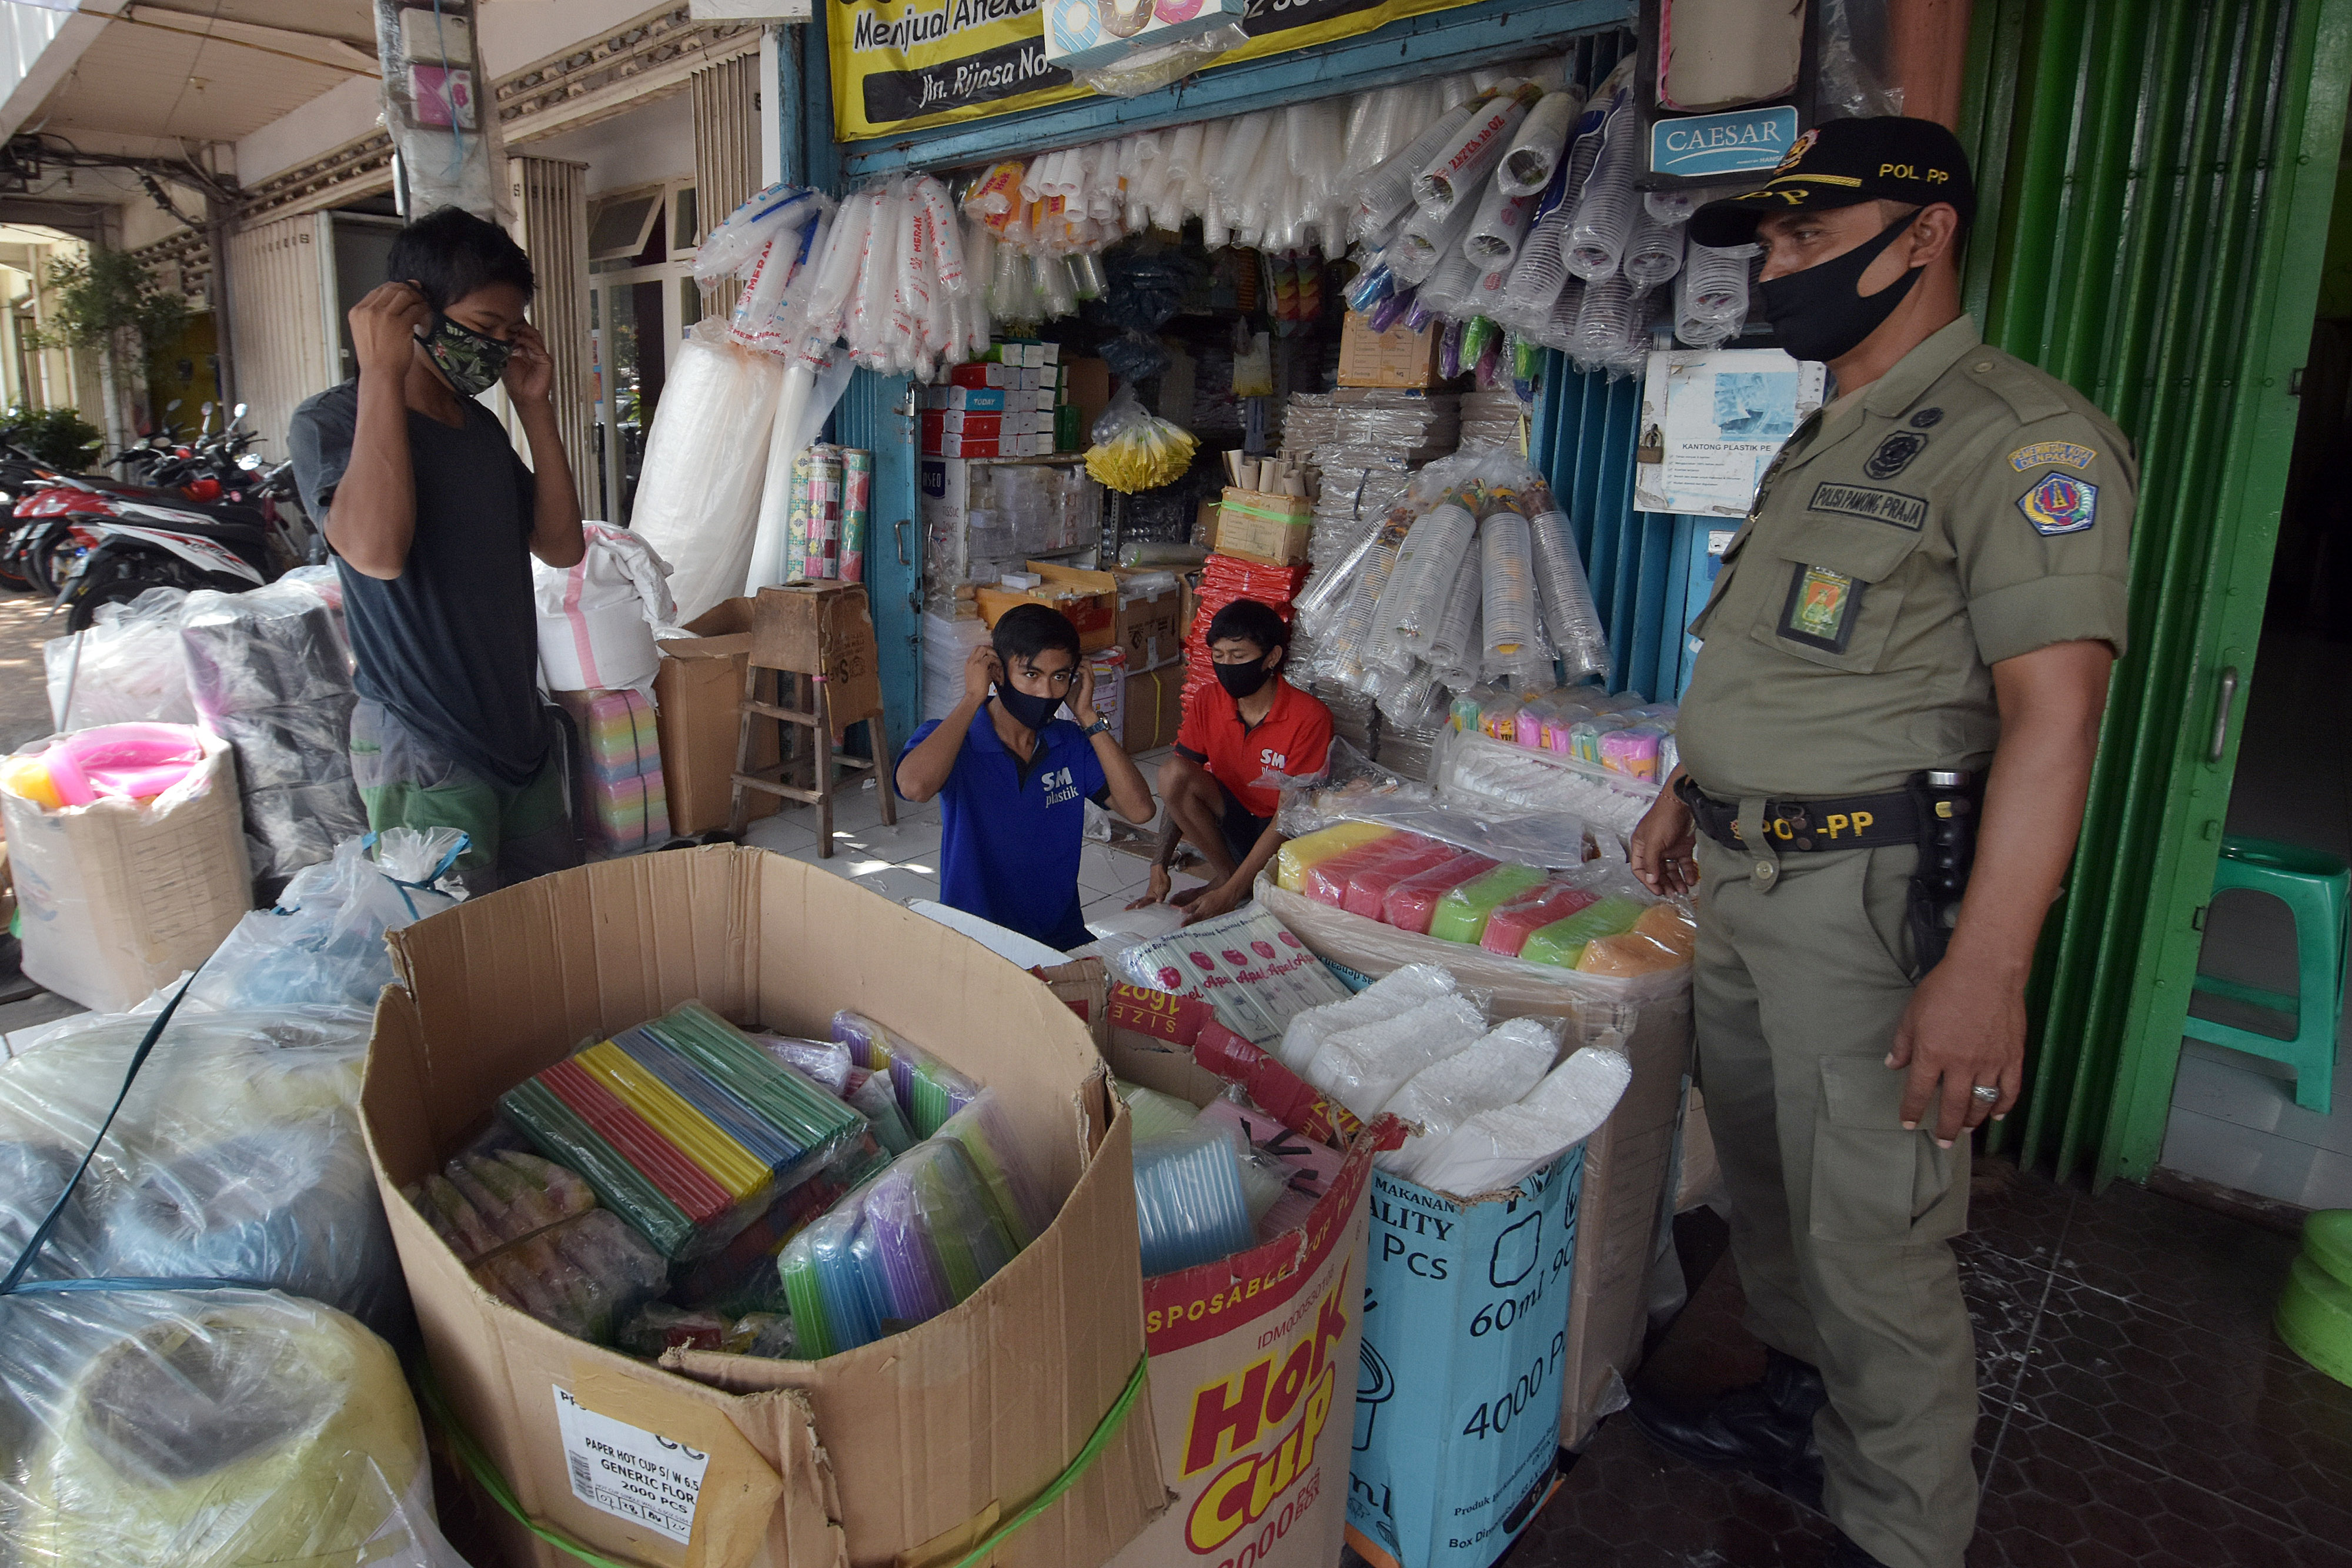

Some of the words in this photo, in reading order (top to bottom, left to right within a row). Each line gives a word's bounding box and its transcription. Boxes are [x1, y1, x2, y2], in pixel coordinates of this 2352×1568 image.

[854, 9, 949, 52] Menjual
[953, 62, 1014, 98] Rijasa
[1019, 46, 1053, 80] No.
[1666, 121, 1782, 152] CAESAR
[1879, 163, 1920, 180] POL
[1927, 168, 1949, 185] PP
[913, 215, 923, 253] MERAK
[973, 397, 996, 406] TODAY
[2020, 453, 2082, 468] DENPASAR
[1815, 487, 1846, 509] POLISI
[1846, 490, 1883, 514] PAMONG
[1880, 496, 1922, 524] PRAJA
[1259, 748, 1285, 769] SM
[1041, 766, 1073, 792] SM
[1045, 785, 1080, 809] plastik
[1267, 958, 1298, 976] Apel
[1113, 1005, 1176, 1034] SIZE
[1375, 1176, 1455, 1213] MAKANAN
[1469, 1269, 1545, 1338] 60ml
[1462, 1357, 1544, 1440] 4000
[585, 1437, 616, 1458] PAPER
[617, 1449, 636, 1466] HOT
[639, 1457, 657, 1474] CUP
[684, 1476, 699, 1492] 6.5
[600, 1458, 659, 1490] GENERIC
[620, 1480, 657, 1502] 2000
[660, 1496, 688, 1515] PCS
[1454, 1496, 1490, 1516] Produk
[1449, 1536, 1473, 1549] Box
